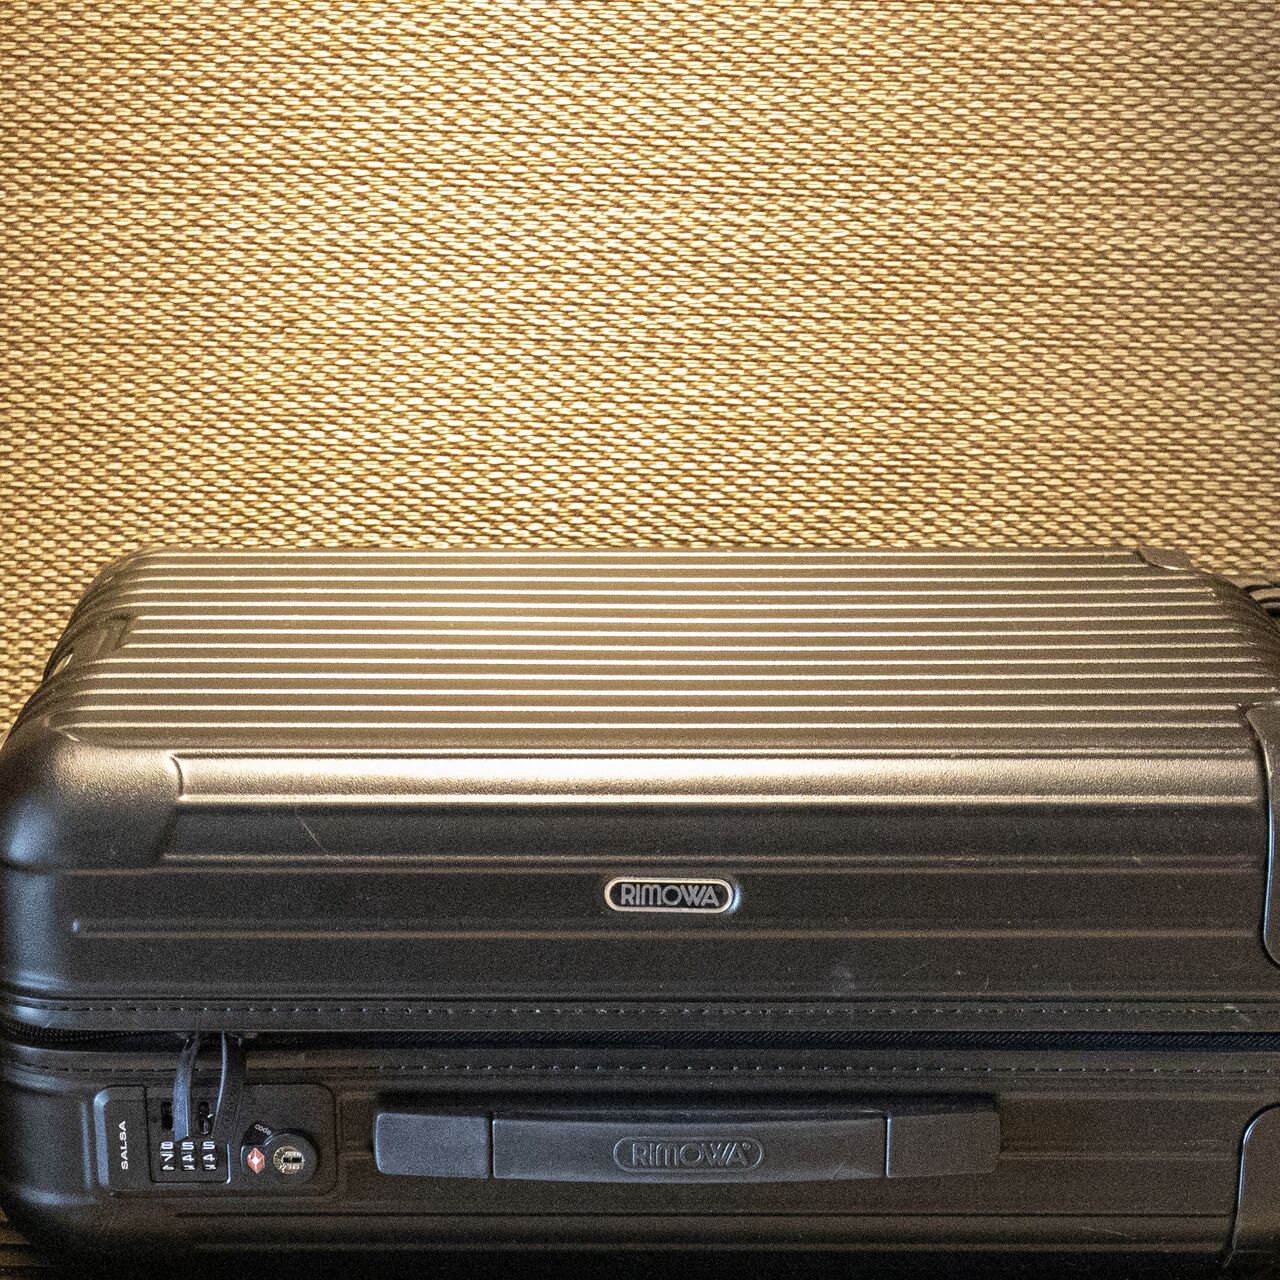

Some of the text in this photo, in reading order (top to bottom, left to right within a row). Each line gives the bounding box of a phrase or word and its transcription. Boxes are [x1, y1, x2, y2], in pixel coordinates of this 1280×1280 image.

[620, 883, 720, 907] RIMOWA
[254, 1123, 272, 1136] code
[118, 1120, 129, 1170] SALSA
[632, 1142, 751, 1167] RIMOWA
